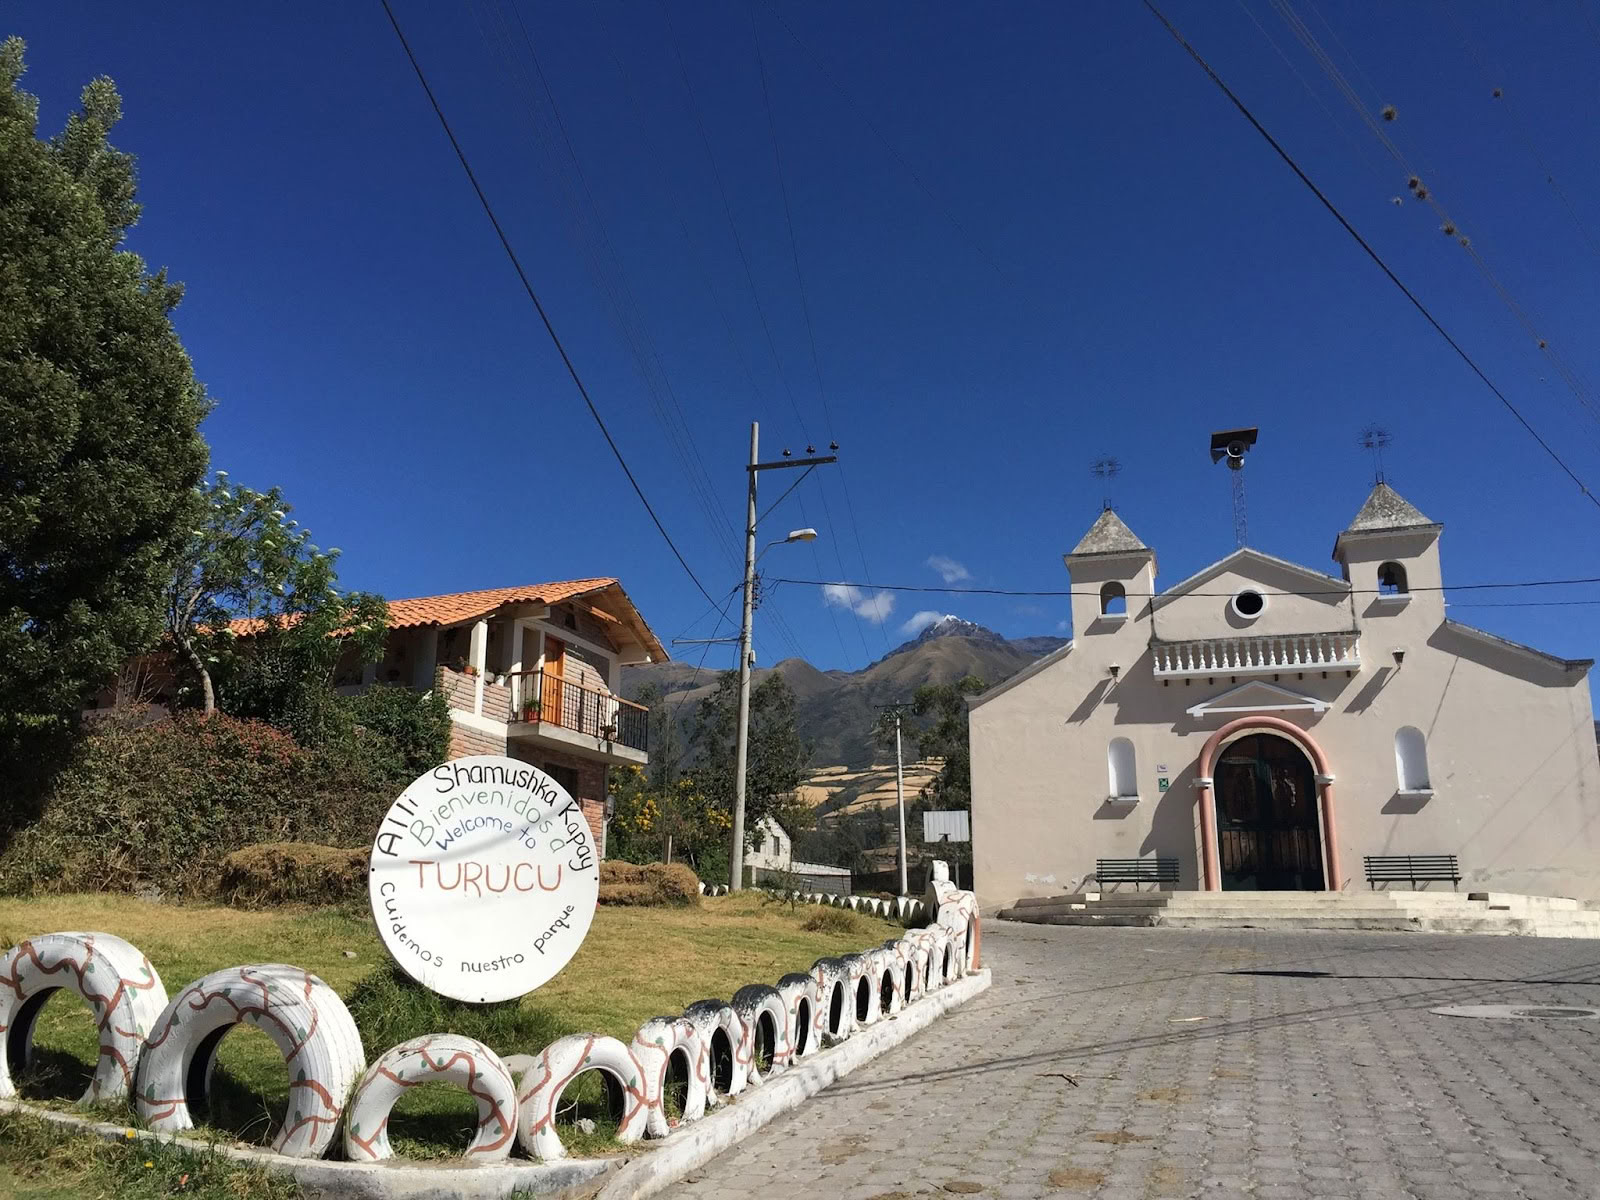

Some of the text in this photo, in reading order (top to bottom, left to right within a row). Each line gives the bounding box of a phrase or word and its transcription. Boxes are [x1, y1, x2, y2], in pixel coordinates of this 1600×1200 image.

[377, 763, 593, 873] Alli Shamushka Kapay
[410, 790, 566, 853] Bienvenidos a
[435, 816, 536, 852] Welcome to
[409, 860, 562, 897] TURUCU
[461, 953, 524, 973] nuestro
[533, 904, 574, 954] parque
